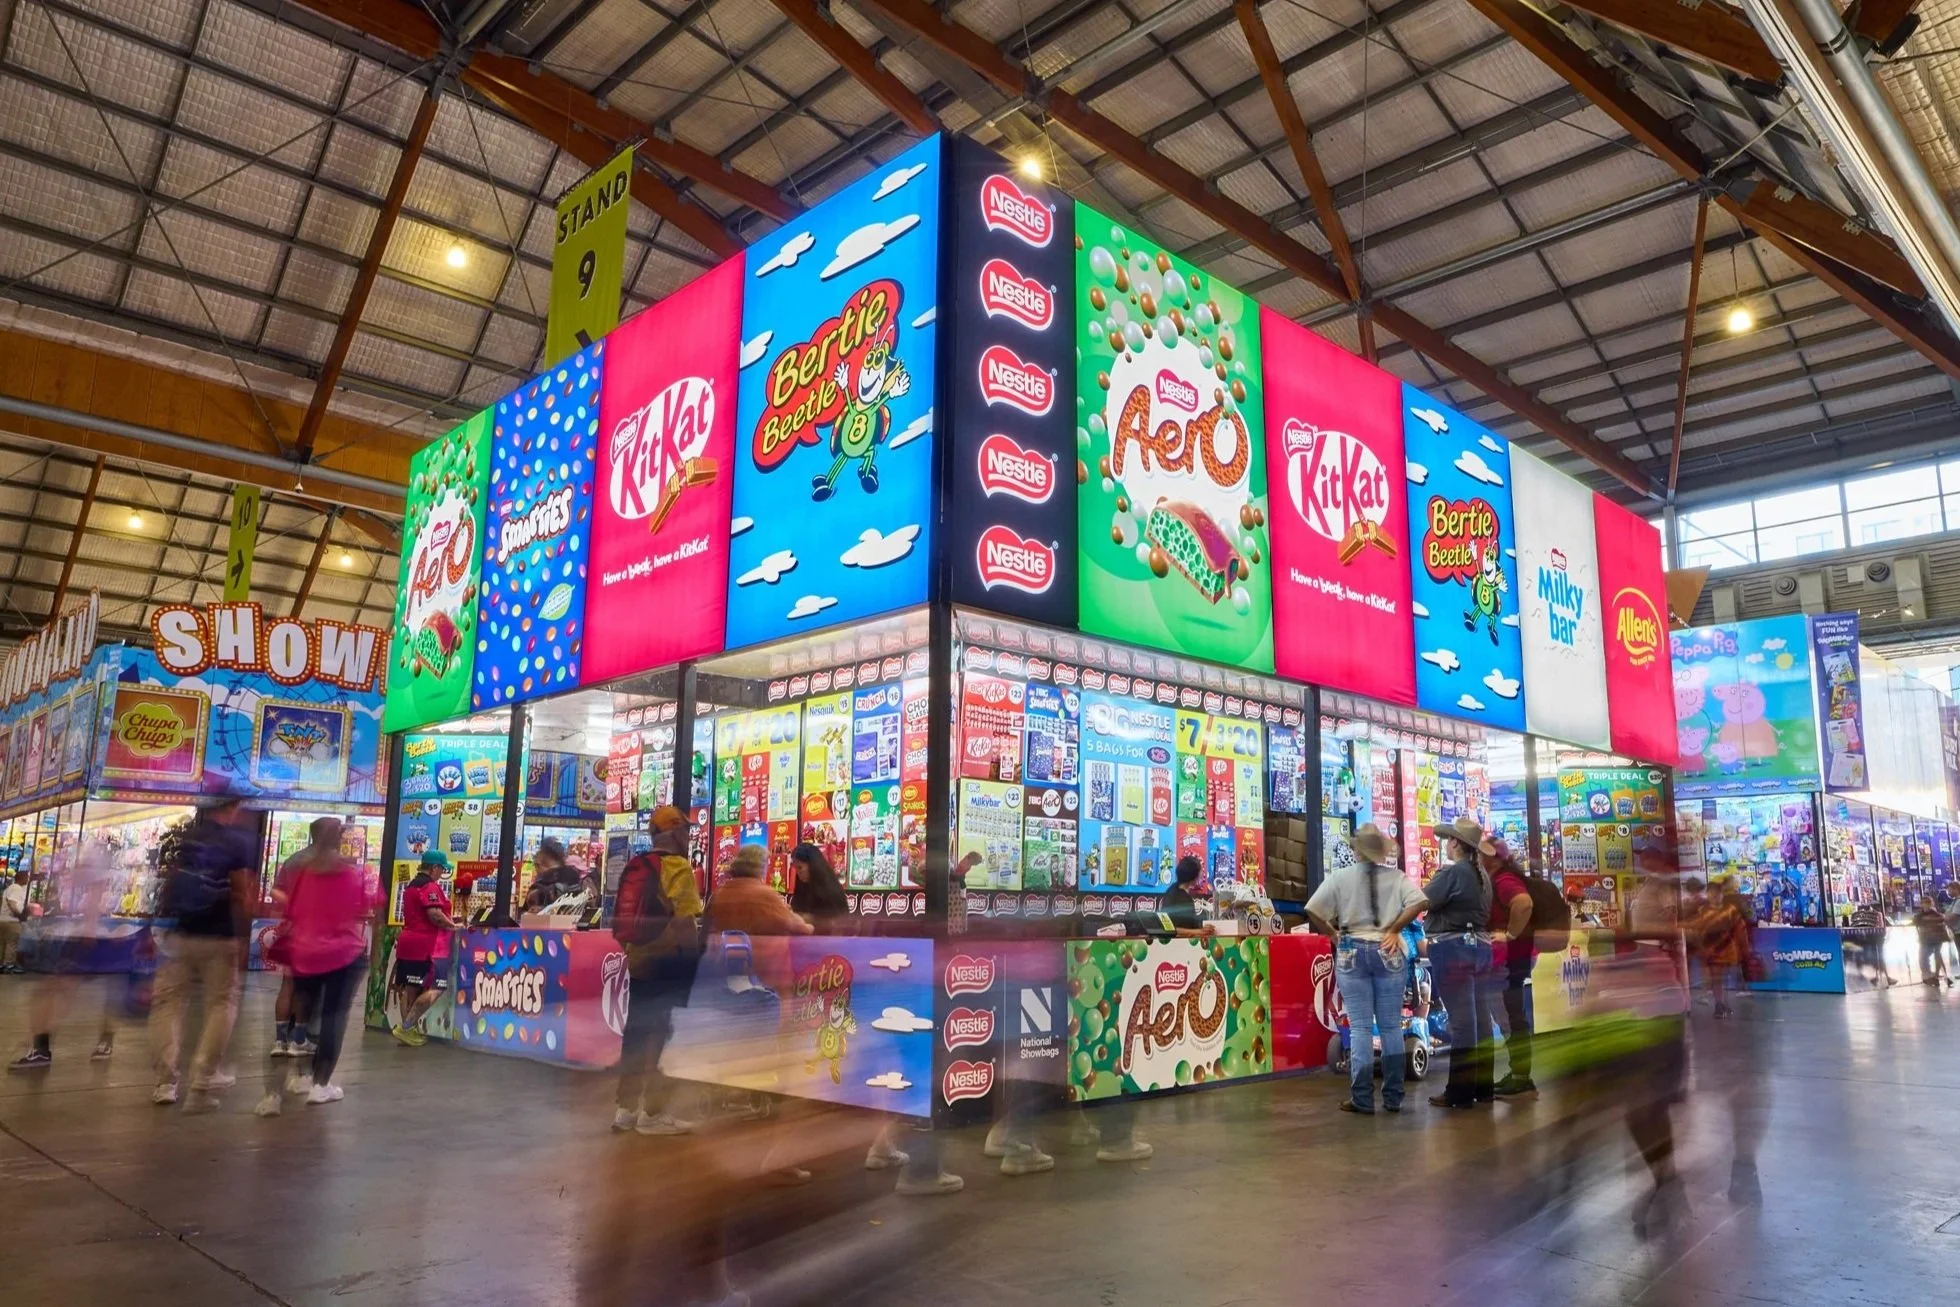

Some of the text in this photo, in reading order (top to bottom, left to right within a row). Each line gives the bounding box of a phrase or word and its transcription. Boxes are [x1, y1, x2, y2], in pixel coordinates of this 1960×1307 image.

[557, 170, 629, 244] STAND
[578, 250, 597, 300] 9
[773, 286, 886, 406] Bertie
[762, 380, 837, 455] Beetle
[620, 381, 709, 515] KitKat
[1112, 385, 1248, 488] Aero
[1300, 435, 1386, 535] KitKat
[238, 495, 252, 531] 10
[1431, 500, 1492, 538] Bertie
[603, 572, 621, 587] Have
[622, 571, 627, 581] a
[653, 554, 672, 569] have
[673, 551, 679, 561] a
[680, 536, 709, 559] KitKat
[1428, 539, 1472, 568] Beetle
[405, 515, 475, 624] Aero
[1290, 567, 1312, 586] Have
[1312, 579, 1319, 588] a
[1346, 586, 1364, 602] have
[1370, 593, 1396, 614] KitKat
[1538, 565, 1583, 620] Milky
[1548, 602, 1577, 647] bar
[1617, 607, 1658, 647] Allen's
[153, 606, 393, 690] SHOW
[1670, 637, 1712, 661] Peppa
[1713, 631, 1737, 655] Pig
[857, 690, 885, 710] CRUNCH
[907, 700, 928, 714] CHO
[129, 714, 179, 732] Chupa
[1130, 711, 1171, 730] NESTLE
[1180, 718, 1200, 748] $7
[126, 727, 174, 749] Chups
[441, 740, 507, 749] TRIPLE DEAL
[1087, 740, 1094, 751] 5
[1096, 741, 1124, 756] BAGS
[1126, 745, 1145, 759] FOR
[1588, 772, 1618, 780] TRIPLE
[970, 796, 1001, 808] Milkybar
[1007, 793, 1019, 801] $23
[1043, 795, 1060, 808] Aero
[1250, 919, 1258, 929] $5
[1272, 919, 1281, 929] $12
[1562, 957, 1591, 989] Milky
[1122, 969, 1227, 1071] Aero
[1020, 1036, 1052, 1049] National
[1020, 1048, 1060, 1060] Showbags
